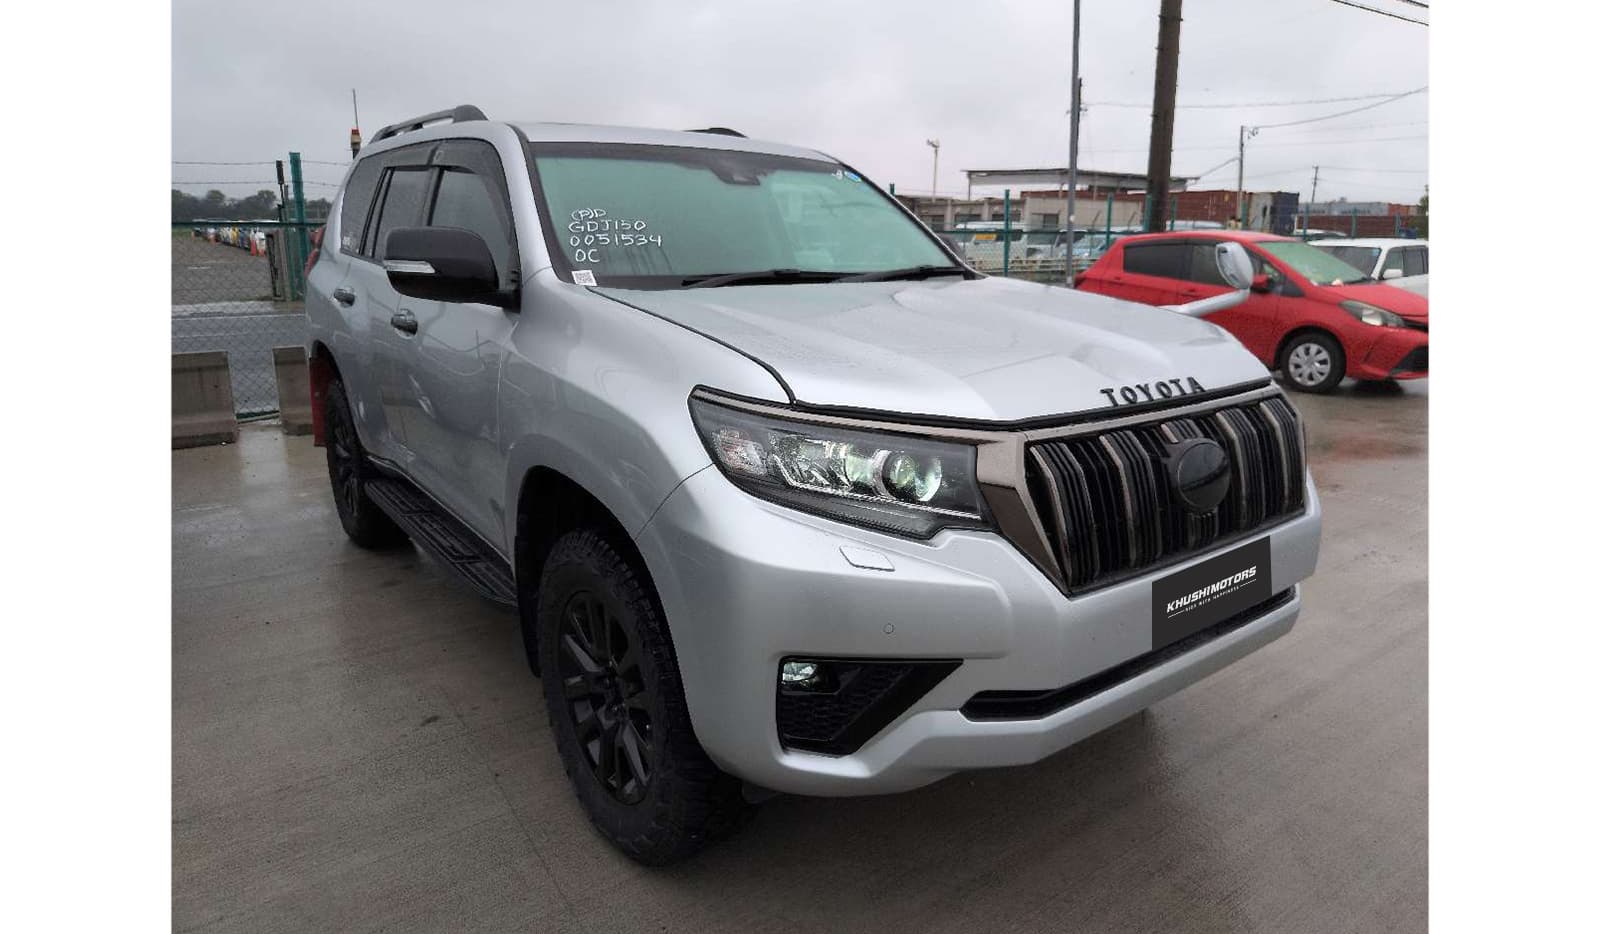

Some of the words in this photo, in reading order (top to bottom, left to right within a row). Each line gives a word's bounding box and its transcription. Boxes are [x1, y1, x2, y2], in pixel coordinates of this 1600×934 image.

[568, 220, 647, 233] GDJ150
[570, 233, 662, 247] 0051534
[1099, 376, 1206, 406] TOYOTA
